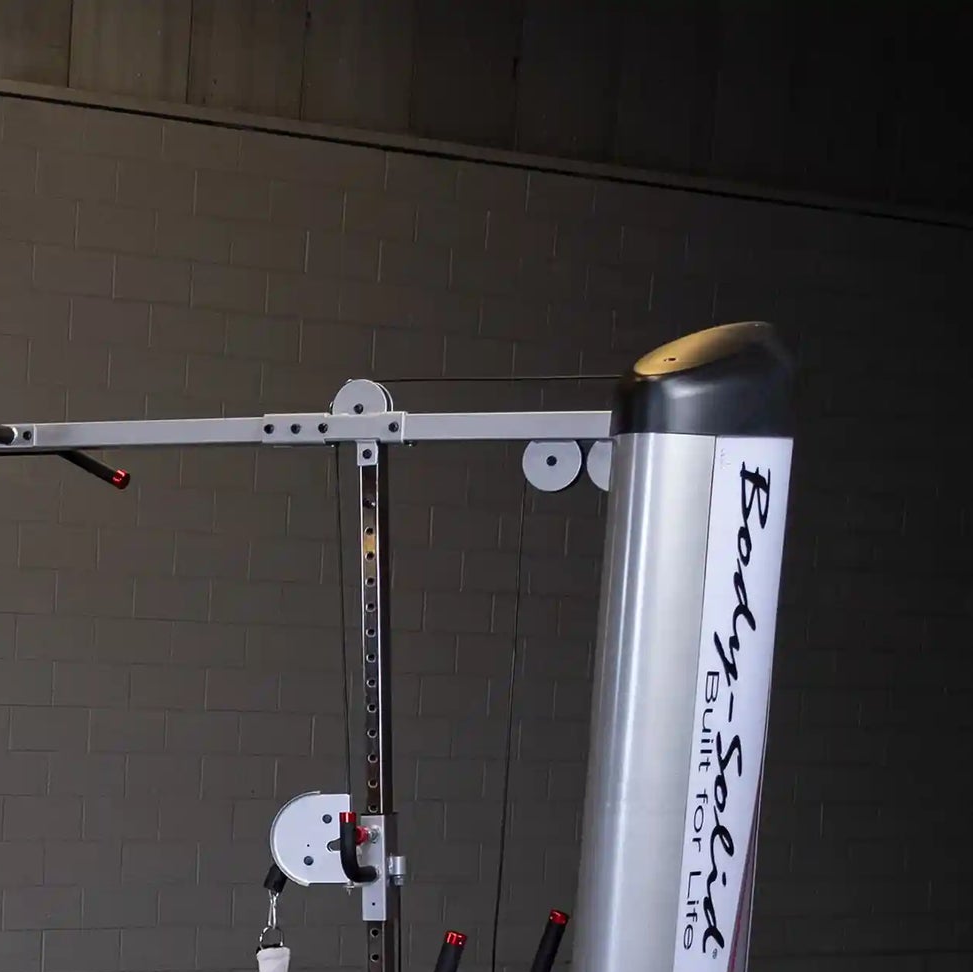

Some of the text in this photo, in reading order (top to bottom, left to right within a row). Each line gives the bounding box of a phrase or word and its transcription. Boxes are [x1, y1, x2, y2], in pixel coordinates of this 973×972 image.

[683, 671, 720, 950] Built for Life
